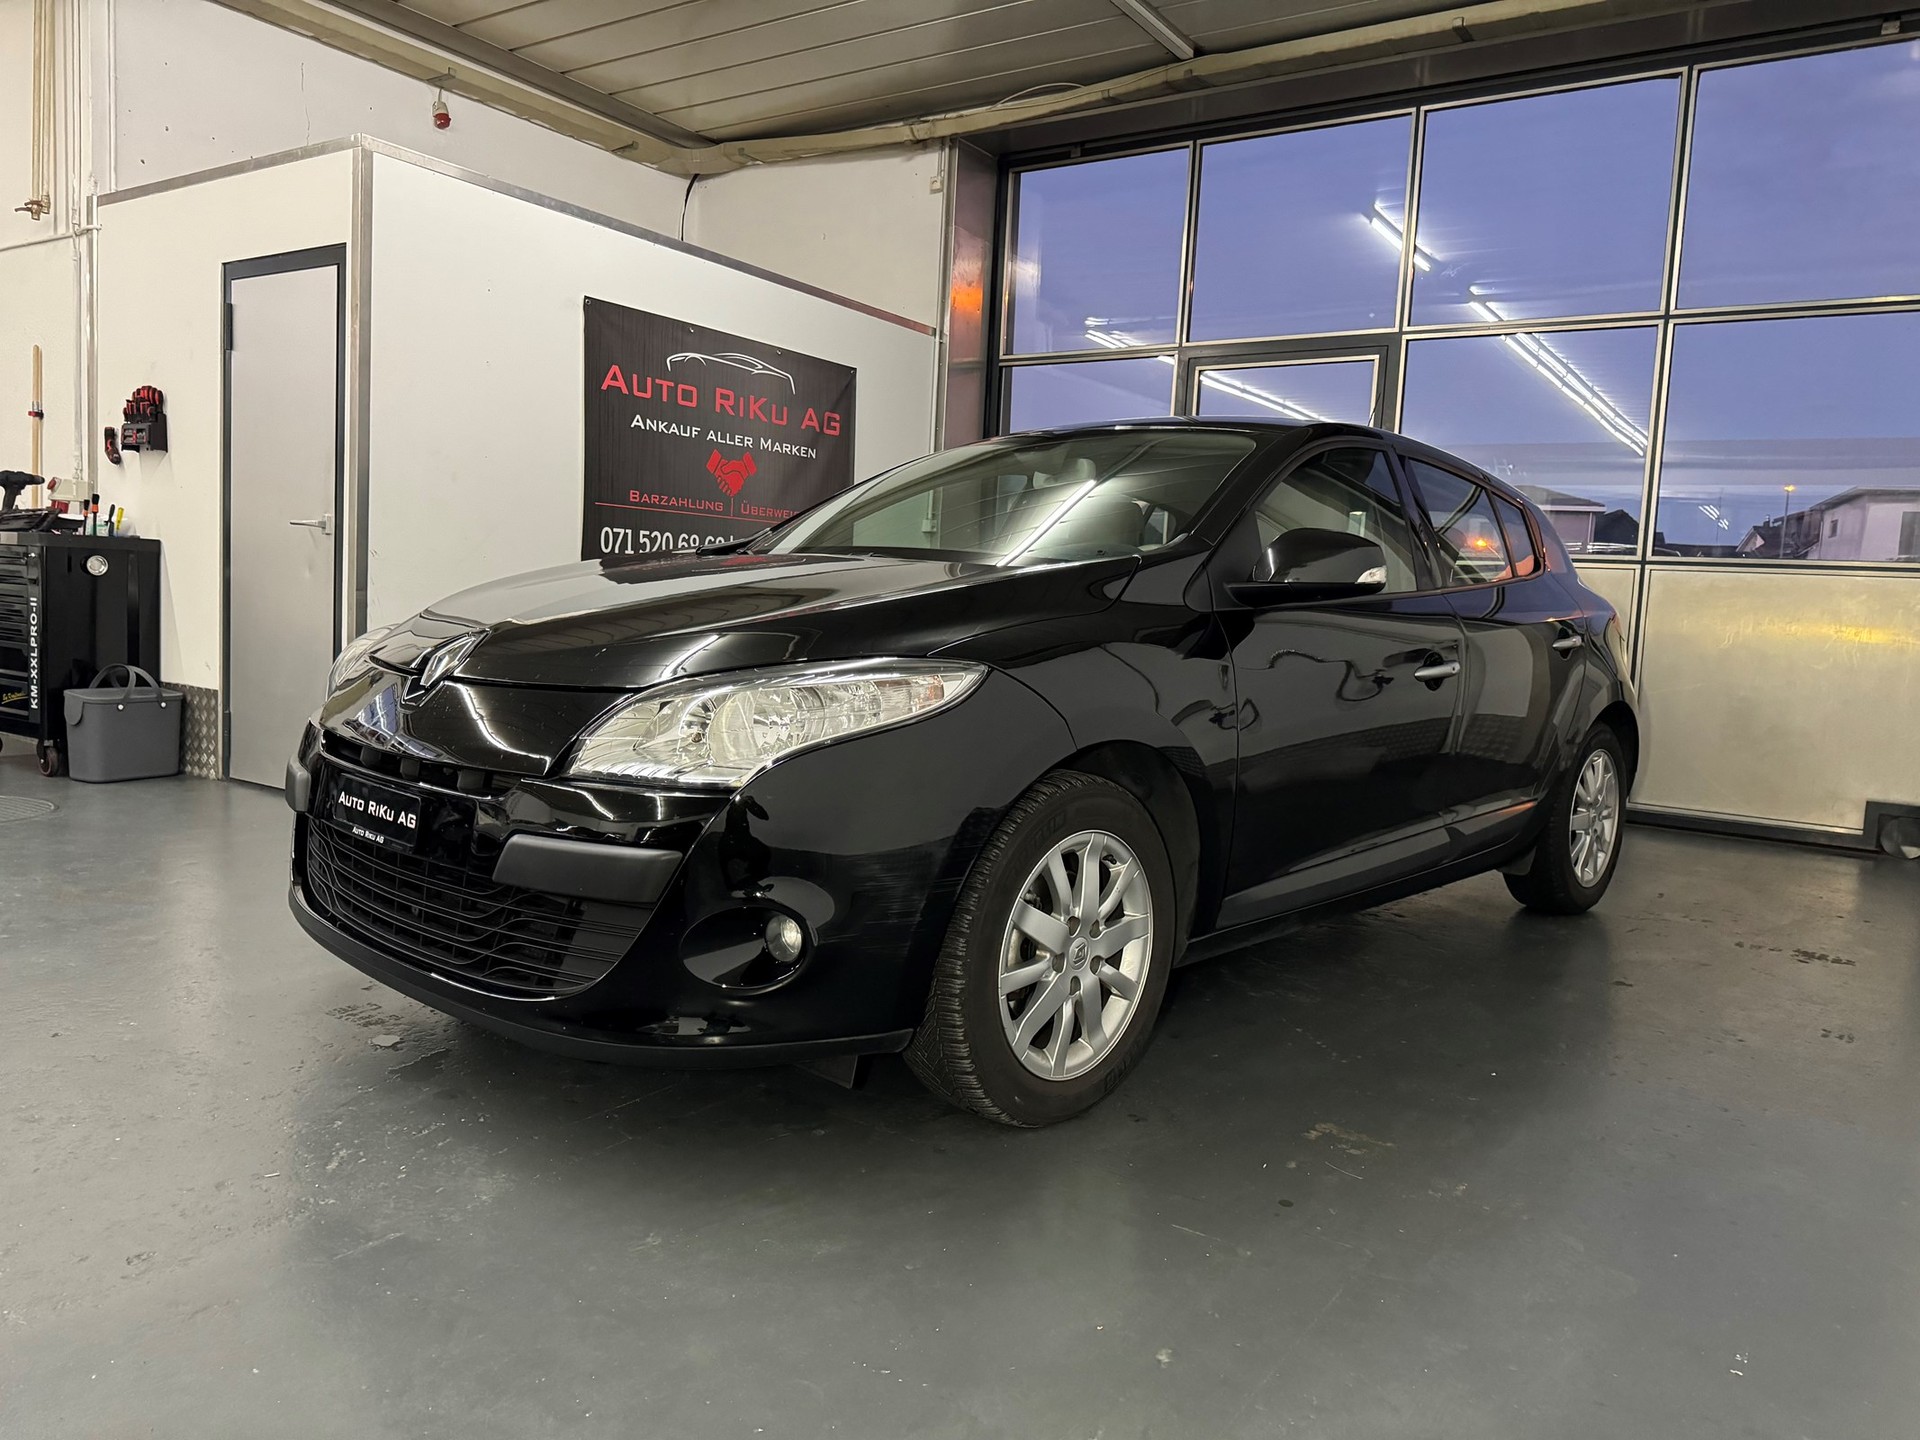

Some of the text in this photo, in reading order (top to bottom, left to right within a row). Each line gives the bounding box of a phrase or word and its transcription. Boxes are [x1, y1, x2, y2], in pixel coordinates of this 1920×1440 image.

[801, 407, 841, 437] AG
[706, 429, 753, 449] ALLER
[600, 526, 635, 555] 071
[639, 530, 673, 553] 520
[397, 810, 417, 829] AG
[375, 835, 385, 844] AG
